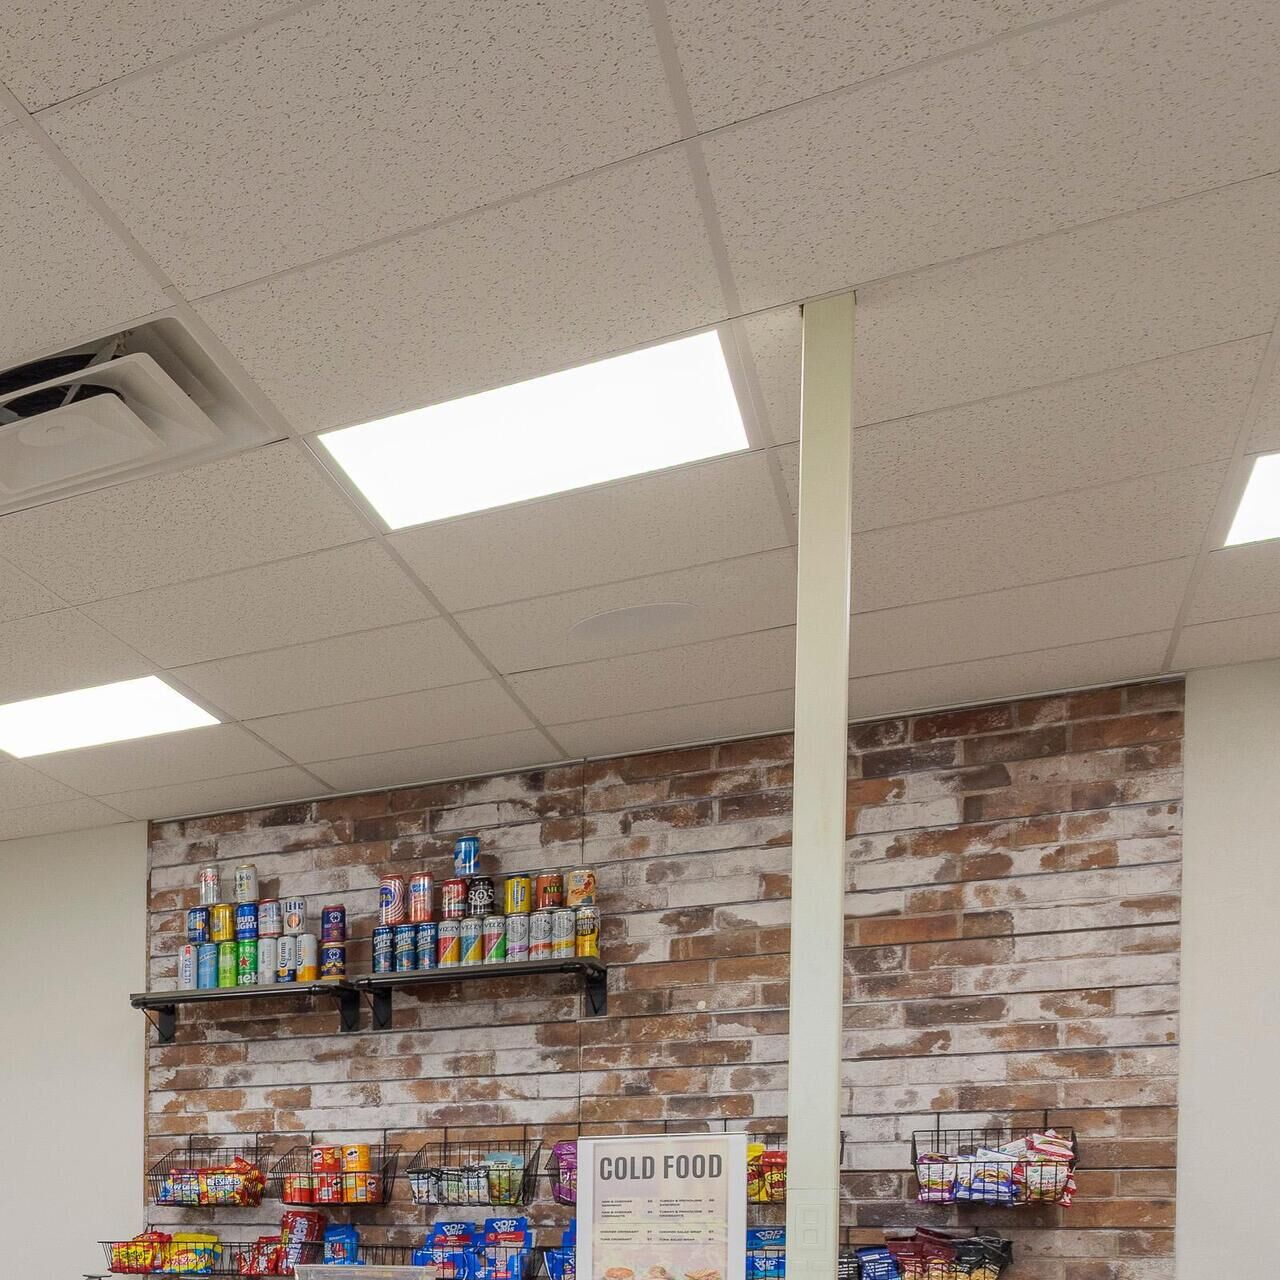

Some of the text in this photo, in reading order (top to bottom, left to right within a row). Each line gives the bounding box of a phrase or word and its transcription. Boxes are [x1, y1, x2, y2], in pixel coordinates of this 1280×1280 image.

[468, 889, 494, 903] 805
[600, 1154, 722, 1181] COLD FOOD
